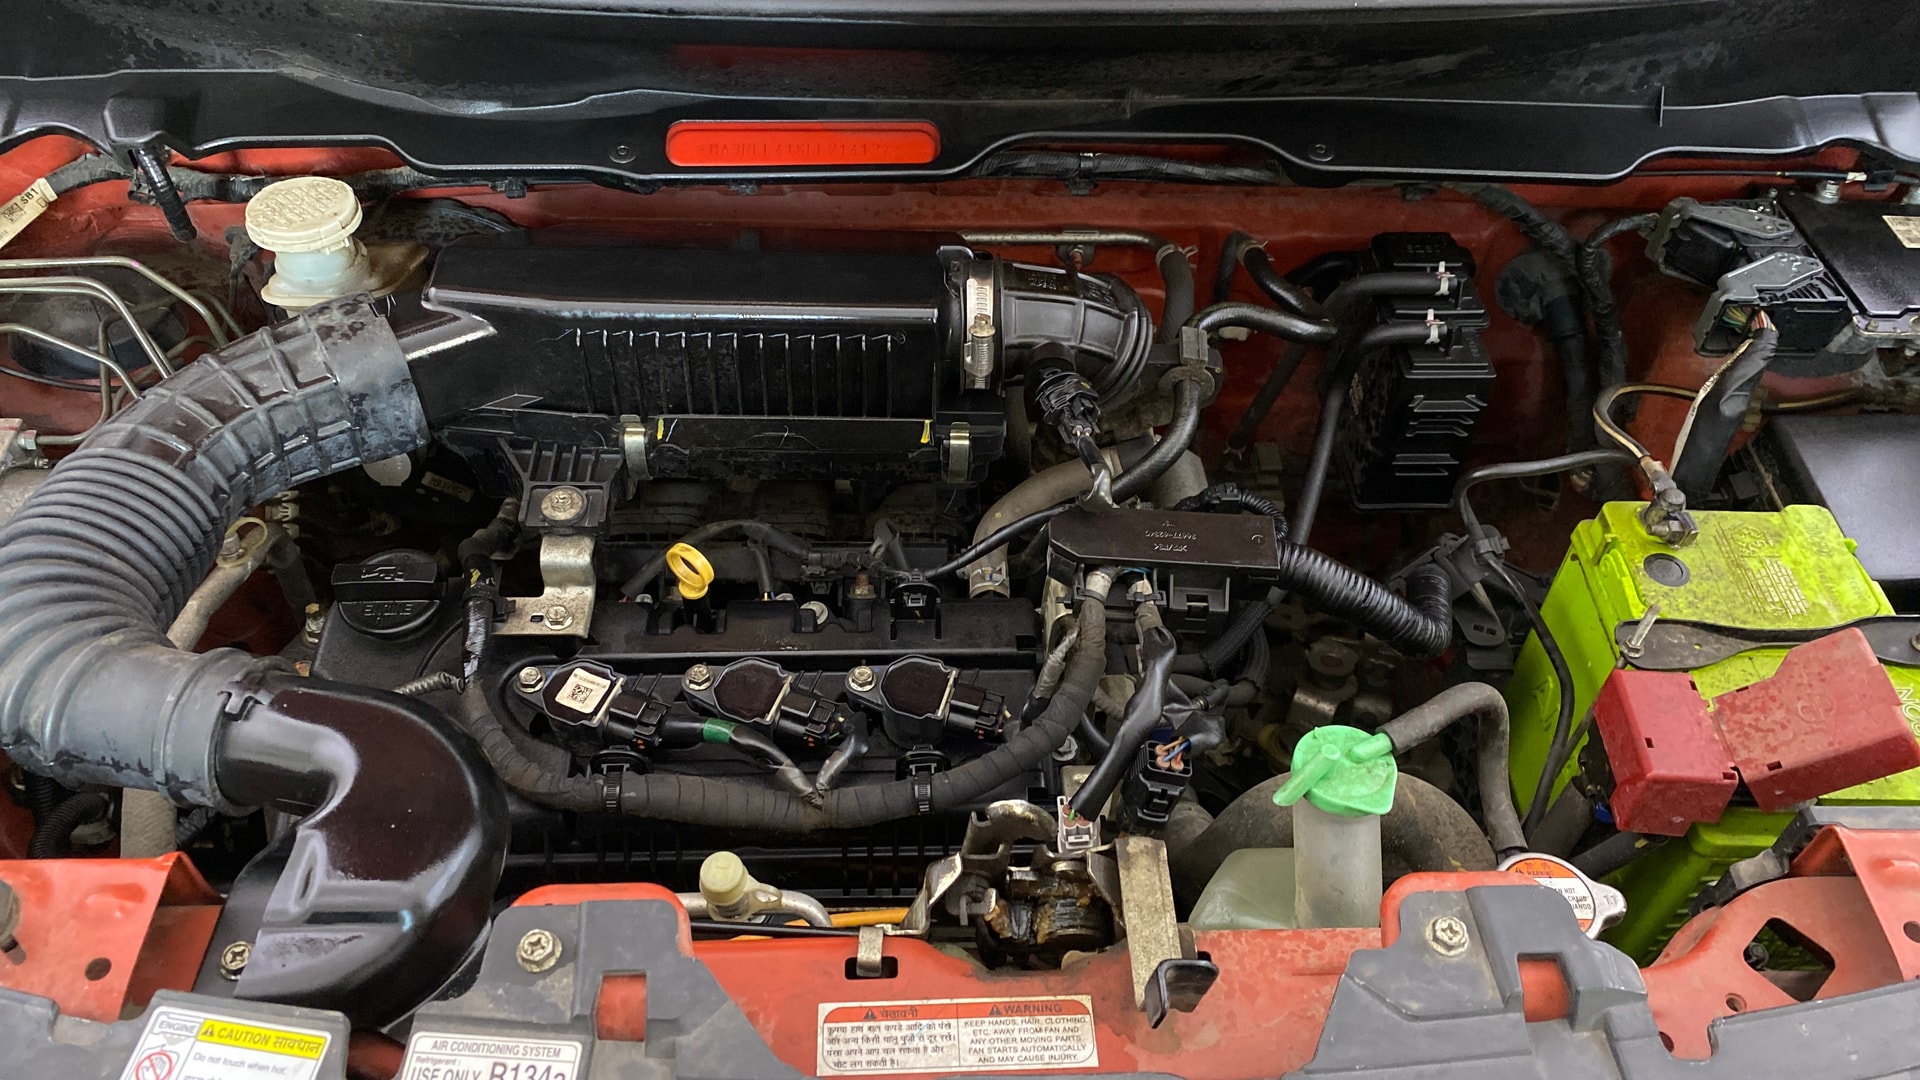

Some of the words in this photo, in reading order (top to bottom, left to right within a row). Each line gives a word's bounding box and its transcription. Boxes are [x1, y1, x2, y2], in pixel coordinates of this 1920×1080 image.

[20, 188, 39, 204] SB1
[1003, 1003, 1063, 1014] WARNING
[158, 1020, 197, 1035] ENGINE
[964, 1019, 986, 1027] KEEP
[993, 1028, 1016, 1036] AWAY
[1018, 1026, 1042, 1035] FROM
[1044, 1026, 1060, 1034] FAN
[1062, 1025, 1080, 1033] AND
[217, 1027, 271, 1046] CAUTION
[273, 1035, 323, 1055] सावधान
[988, 1036, 1017, 1045] OTHER
[1020, 1035, 1053, 1044] MOVING
[431, 1039, 449, 1052] AIR
[450, 1040, 521, 1056] CONDITIONING
[521, 1045, 562, 1058] SYSTEM
[968, 1047, 985, 1055] FAN
[987, 1045, 1019, 1054] STARTS
[1020, 1043, 1087, 1053] AUTOMATICALLY
[193, 1051, 206, 1062] Do
[207, 1054, 222, 1064] not
[223, 1056, 246, 1068] touch
[247, 1060, 270, 1072] when
[997, 1055, 1016, 1063] MAY
[1017, 1054, 1046, 1062] CAUSE
[411, 1066, 441, 1080] USE
[443, 1068, 483, 1080] ONLY
